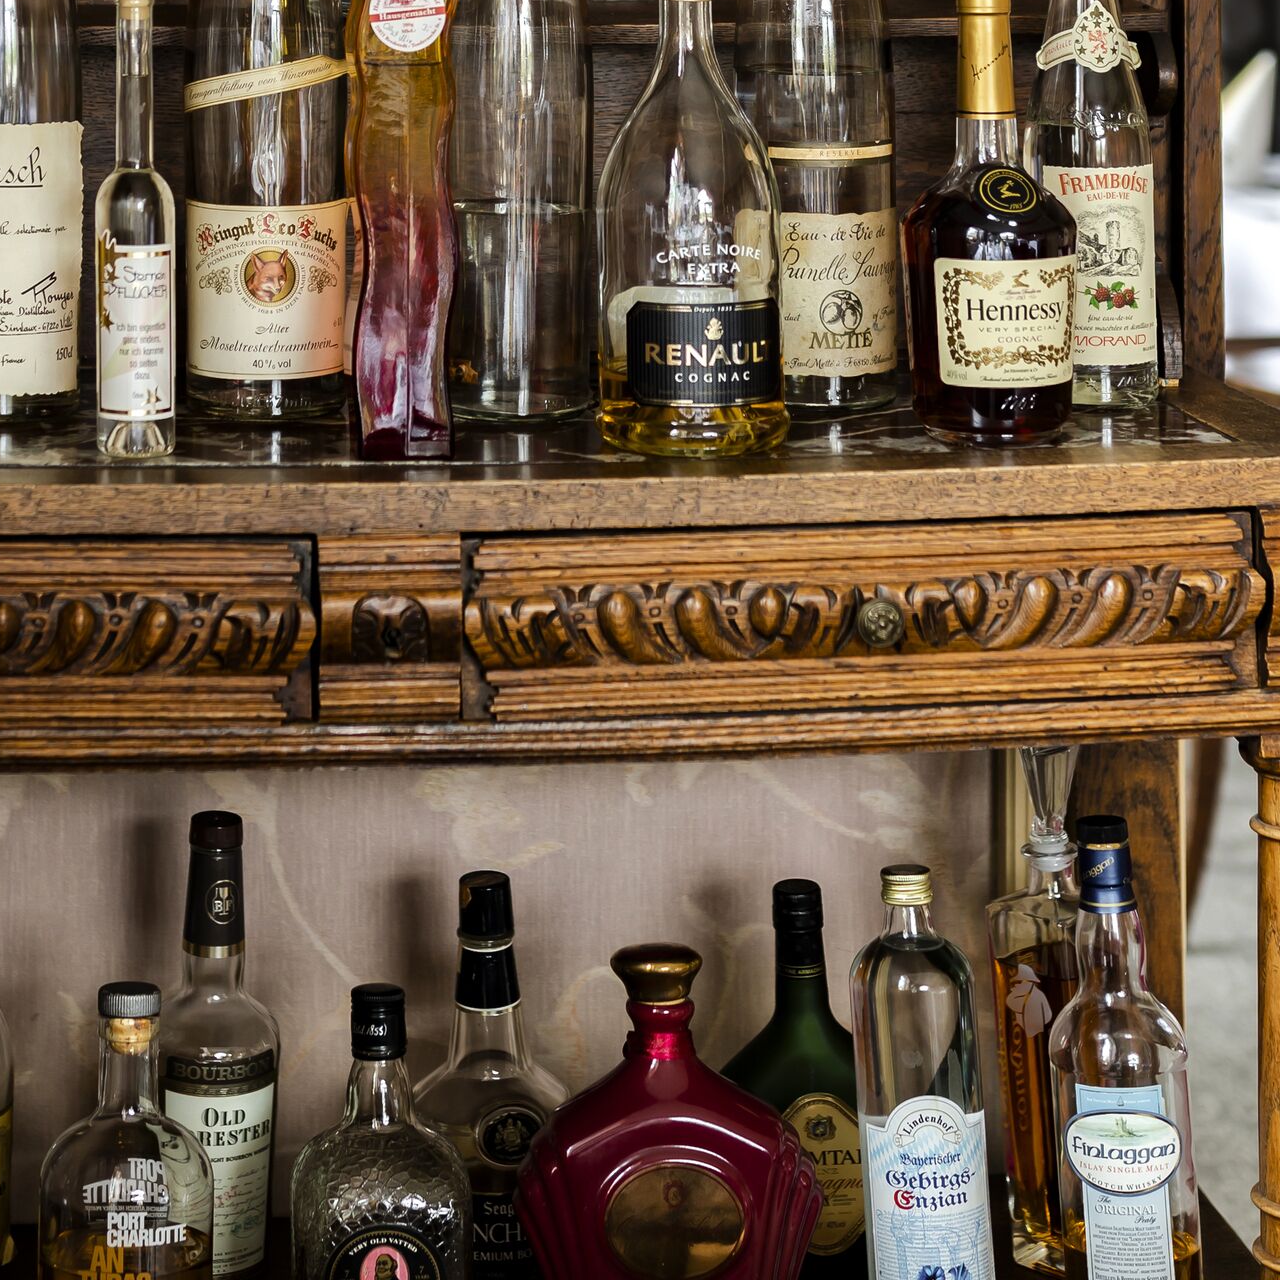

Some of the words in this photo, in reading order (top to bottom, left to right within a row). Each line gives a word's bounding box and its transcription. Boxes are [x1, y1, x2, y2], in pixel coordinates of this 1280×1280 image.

[379, 8, 436, 21] Hausgemacht
[256, 210, 296, 239] Leo
[655, 244, 712, 265] CARTE
[716, 243, 762, 260] NOIRE
[686, 262, 741, 276] EXTRA
[965, 298, 1065, 323] Hennessy
[254, 322, 292, 336] Alter
[978, 326, 1009, 334] VERY
[1014, 325, 1057, 333] SPECIAL
[199, 335, 339, 353] Moseltresterbranntwein
[997, 334, 1044, 344] COGNAC
[644, 339, 769, 368] RENAULT
[277, 358, 292, 369] vol
[674, 370, 752, 384] COGNAC
[173, 1056, 274, 1082] BOURBON
[201, 1106, 246, 1129] OLD
[902, 1113, 955, 1136] Lindenhof
[194, 1118, 271, 1148] RESTER
[899, 1152, 961, 1168] Bayerischer
[1079, 1160, 1104, 1173] ISLAY
[1106, 1164, 1143, 1174] SINGLE
[1145, 1162, 1170, 1173] MALT
[885, 1166, 977, 1191] Gebirgs-
[1086, 1172, 1124, 1191] SCOTCH
[1125, 1174, 1163, 1191] WHISKY
[893, 1189, 968, 1212] Enzian
[1094, 1204, 1158, 1217] ORIGINAL
[106, 1211, 148, 1231] PORT
[106, 1222, 187, 1248] CHARLOTTE
[347, 1240, 369, 1257] VERY
[370, 1237, 388, 1245] OLD
[388, 1237, 419, 1254] VATTED
[472, 1250, 514, 1262] EMIUM
